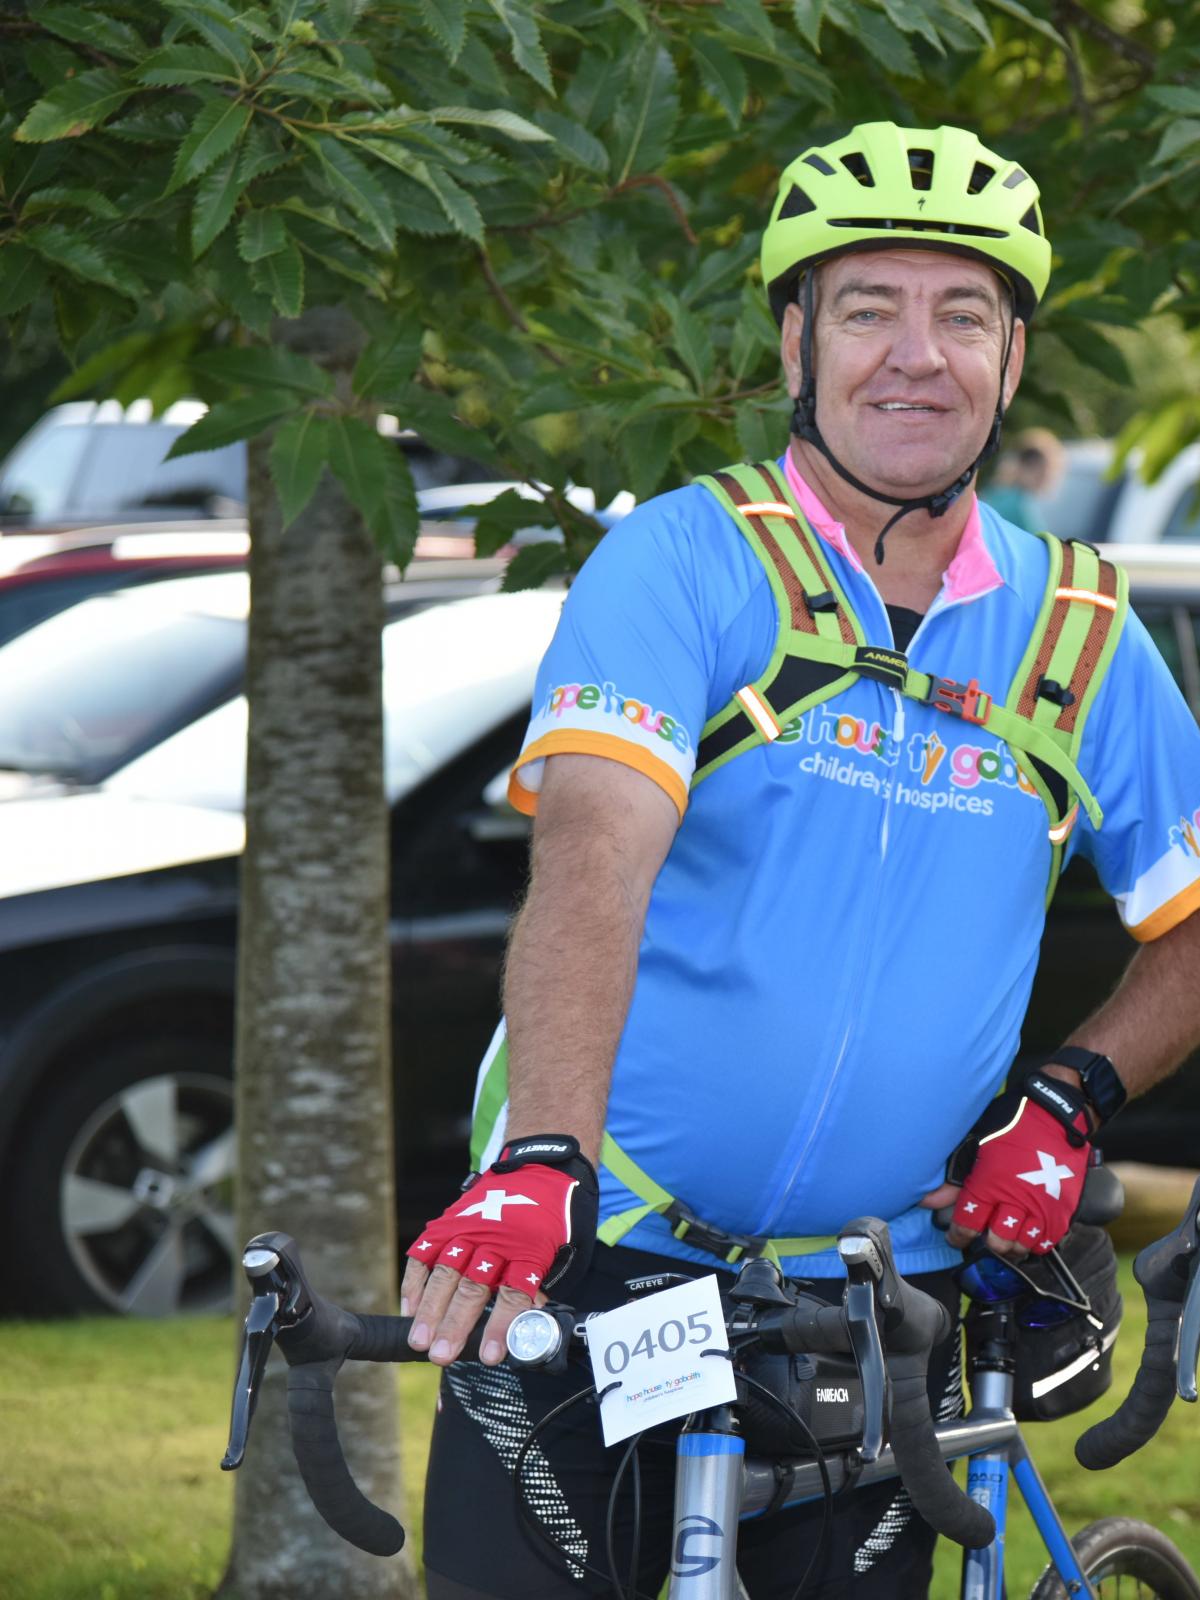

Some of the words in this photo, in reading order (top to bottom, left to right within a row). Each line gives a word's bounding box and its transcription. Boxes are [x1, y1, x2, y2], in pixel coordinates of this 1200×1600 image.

[602, 681, 690, 755] house
[895, 783, 994, 816] hospices
[630, 1278, 663, 1291] CATEYE
[603, 1310, 713, 1375] 0405
[816, 1387, 849, 1402] FAIREACH
